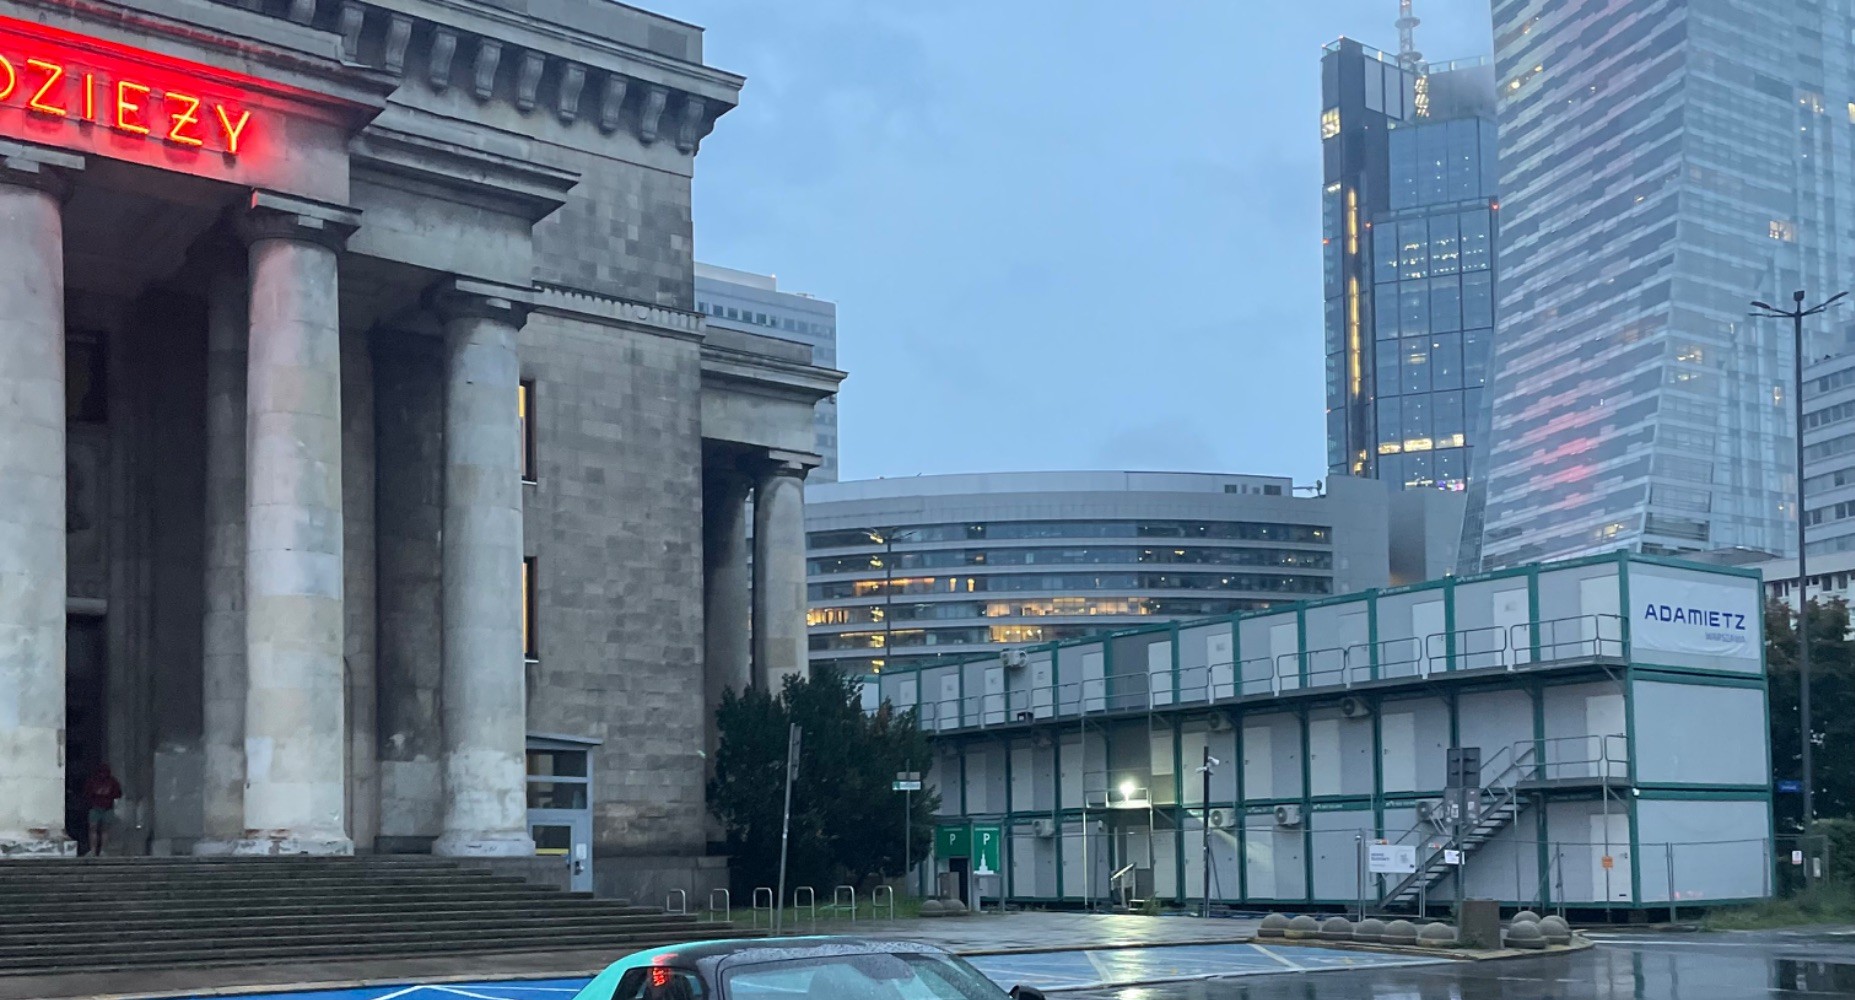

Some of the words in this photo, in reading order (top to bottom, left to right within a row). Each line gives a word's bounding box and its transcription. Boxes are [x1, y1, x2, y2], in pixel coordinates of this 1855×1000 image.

[1644, 603, 1745, 630] ADAMIETZ
[949, 833, 956, 845] P
[983, 833, 990, 845] P
